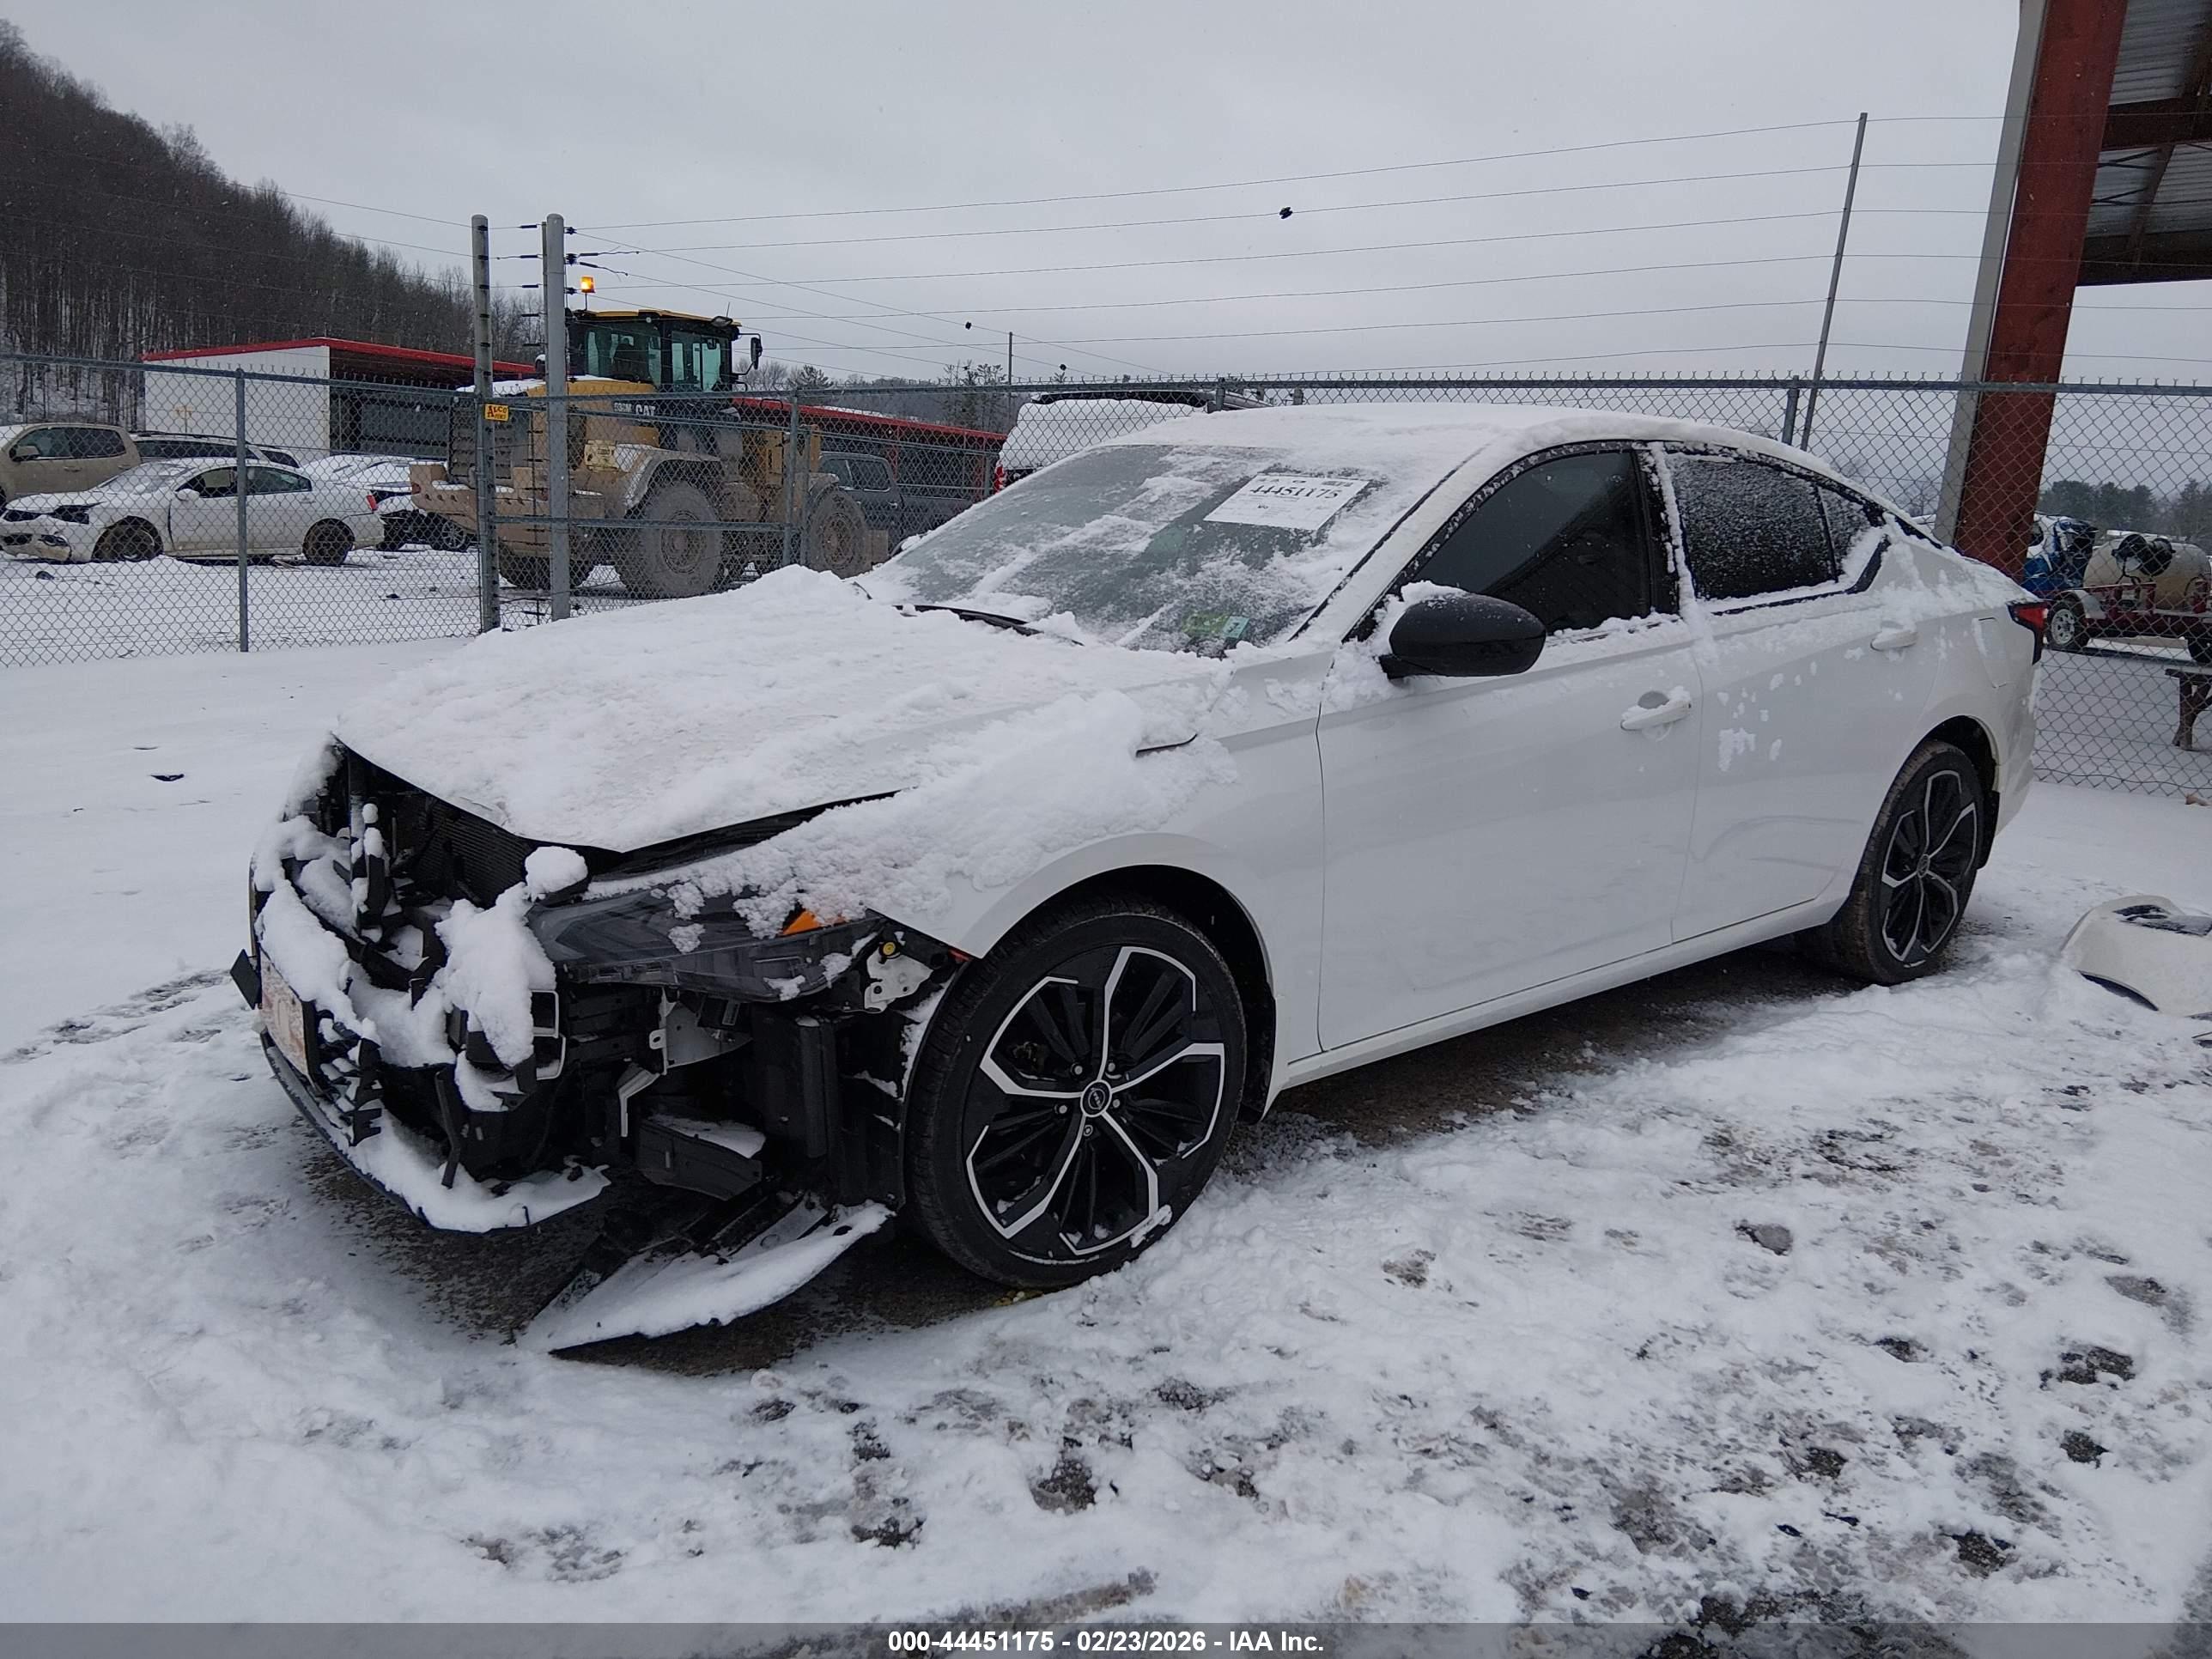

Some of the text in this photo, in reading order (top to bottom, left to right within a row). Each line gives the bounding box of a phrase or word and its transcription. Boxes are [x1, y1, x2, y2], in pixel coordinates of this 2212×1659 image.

[486, 405, 507, 417] ALCO
[635, 404, 656, 416] CAT
[1250, 485, 1341, 499] 44451175
